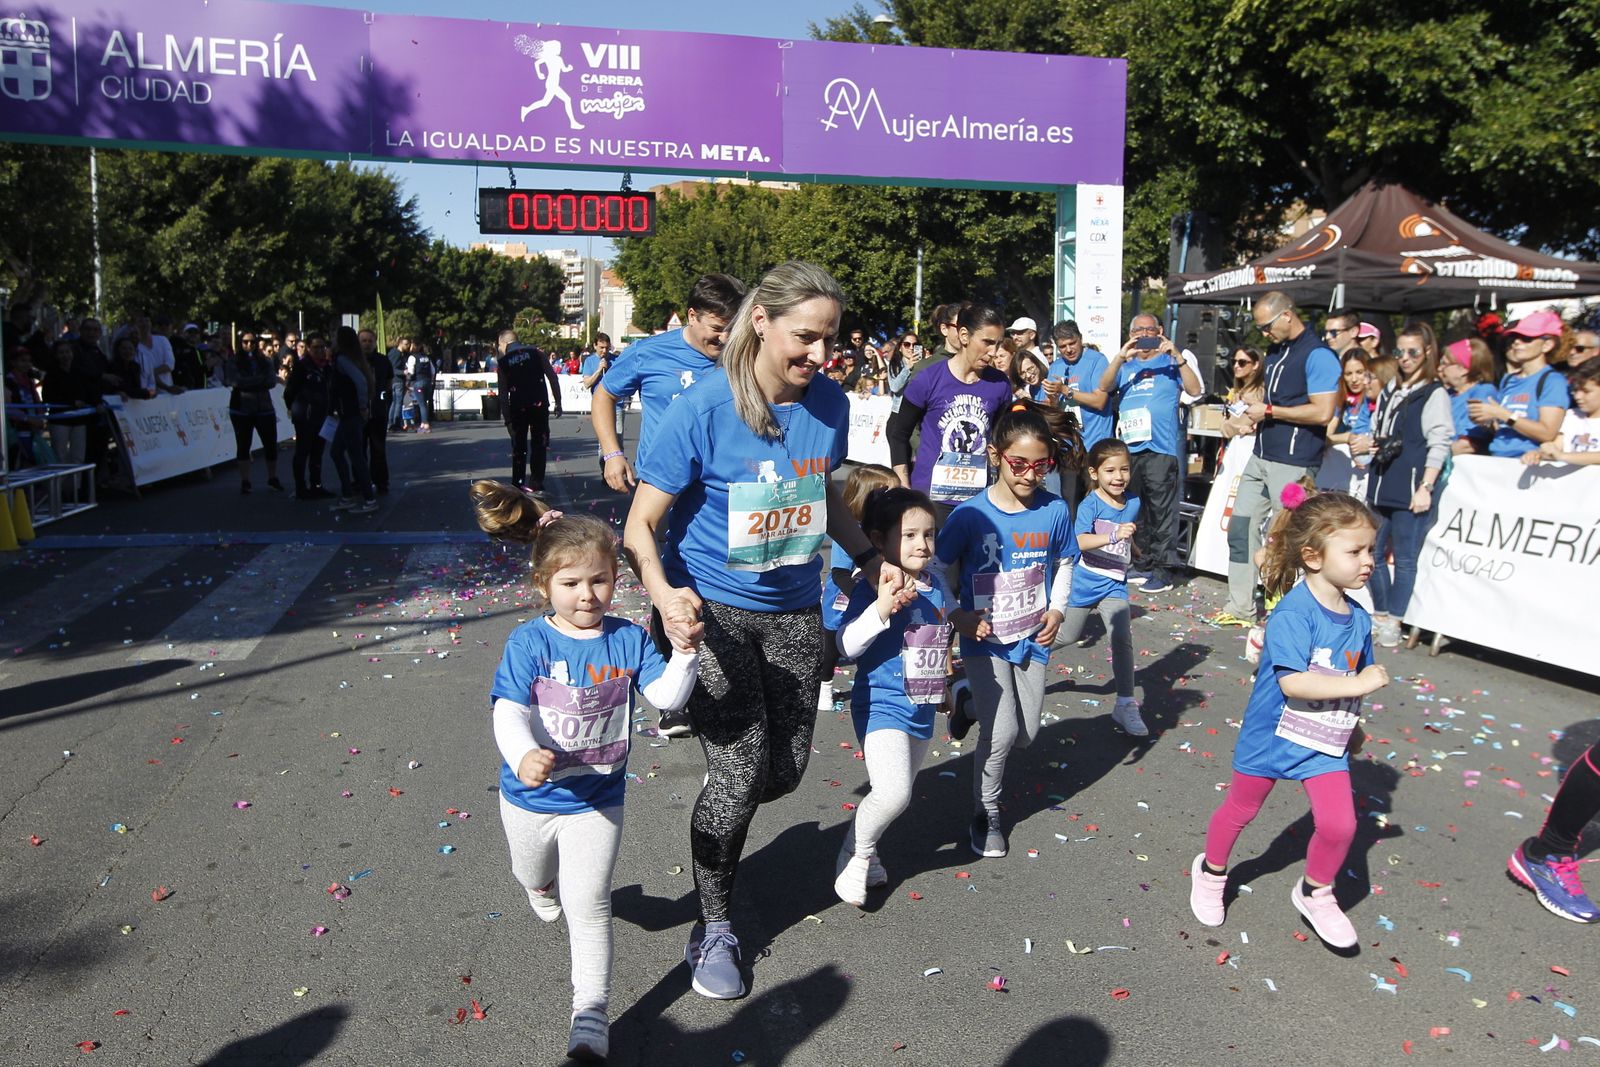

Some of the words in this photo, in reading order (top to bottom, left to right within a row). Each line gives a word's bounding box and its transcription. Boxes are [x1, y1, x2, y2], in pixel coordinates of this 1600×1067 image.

[101, 30, 317, 82] ALMERÍA
[580, 42, 641, 70] VIII
[100, 75, 212, 105] CIUDAD
[580, 73, 644, 86] CARRERA
[580, 91, 646, 120] mujer
[386, 129, 414, 148] LA
[423, 131, 546, 154] IGUALDAD
[556, 137, 581, 155] ES
[590, 138, 694, 160] NUESTRA
[701, 143, 771, 163] META.
[783, 480, 797, 489] VIII
[944, 467, 978, 482] 1257
[748, 505, 812, 535] 2078
[760, 531, 776, 540] MAR
[1011, 532, 1049, 549] VIII
[1431, 545, 1516, 582] CIUDAD
[988, 587, 1037, 613] 3215
[547, 708, 615, 739] 3077
[581, 736, 603, 747] MTNZ
